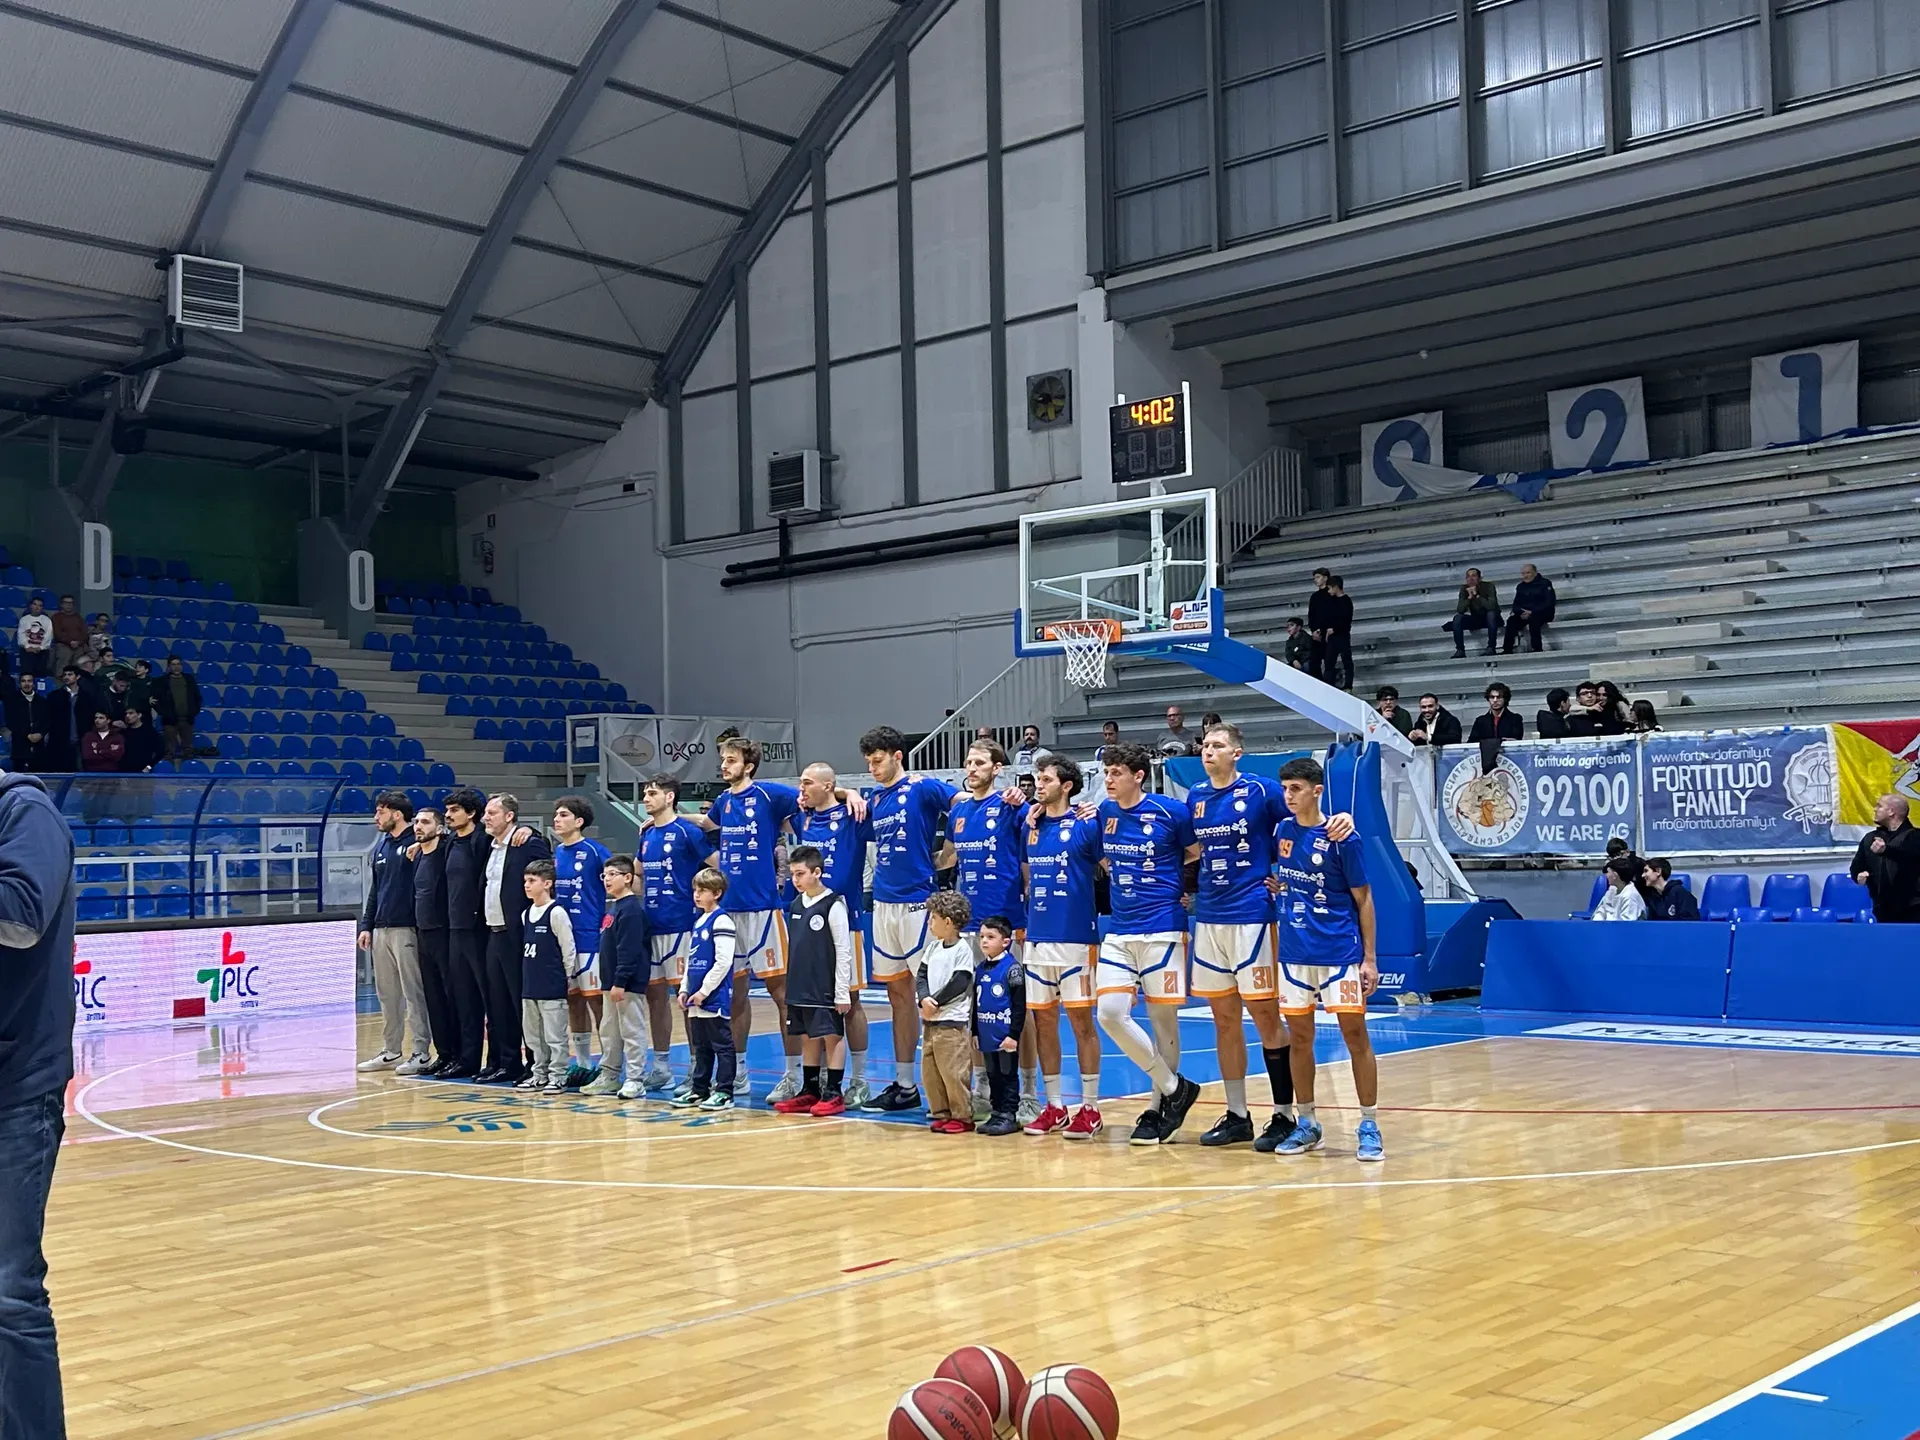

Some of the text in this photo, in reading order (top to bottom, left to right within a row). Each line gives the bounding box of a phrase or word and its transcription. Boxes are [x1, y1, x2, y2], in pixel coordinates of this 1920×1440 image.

[1130, 396, 1175, 425] 4:02
[1566, 388, 1628, 467] 2
[83, 522, 112, 591] D
[1183, 601, 1209, 613] LNP
[1534, 752, 1632, 770] fortitudo agrigento
[1652, 760, 1772, 792] FORTITUDO
[1535, 771, 1631, 818] 92100
[1672, 789, 1755, 818] FAMILY
[1194, 800, 1206, 819] 31
[1104, 817, 1119, 835] 21
[1535, 822, 1631, 842] WE ARE AG
[1652, 814, 1778, 832] info@fortitudofamily.it
[524, 943, 537, 959] 24
[221, 965, 260, 998] PLC
[1164, 970, 1178, 994] 21
[1252, 966, 1273, 990] 31
[1377, 973, 1405, 985] TEM
[1339, 980, 1359, 1004] 99
